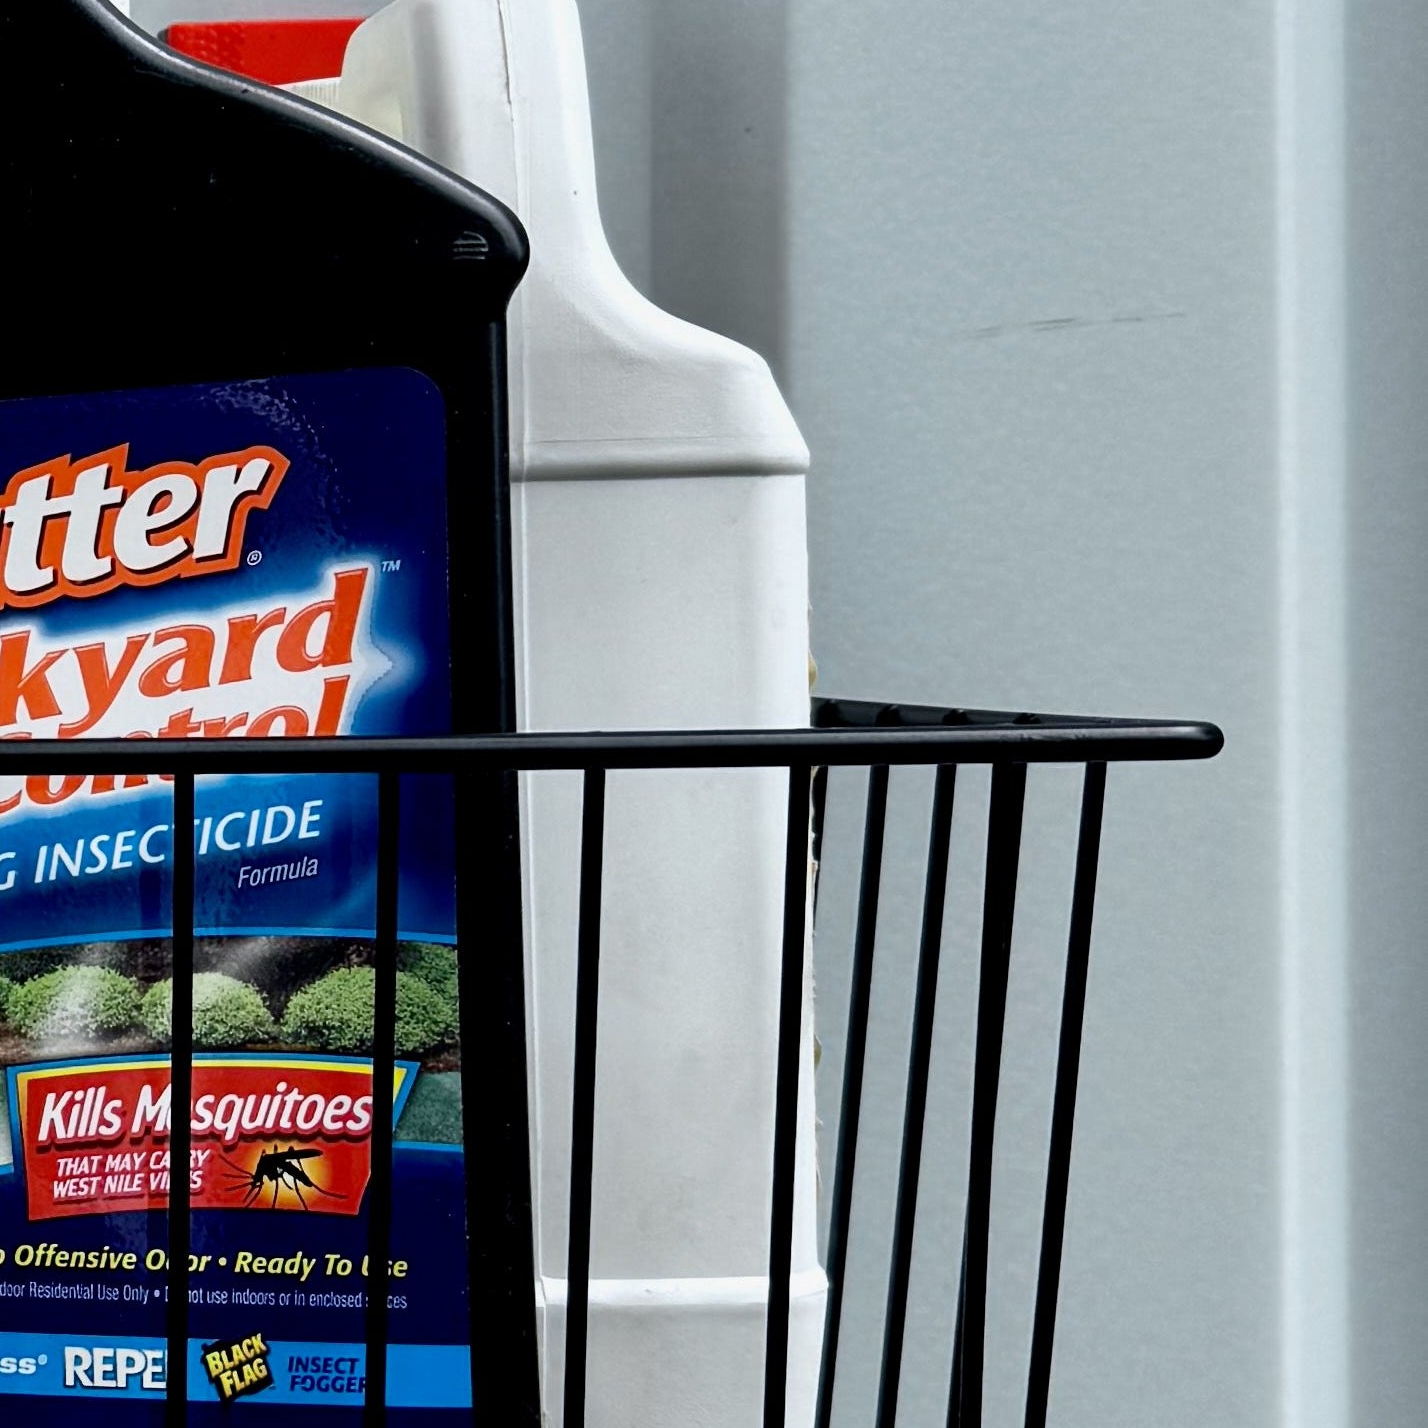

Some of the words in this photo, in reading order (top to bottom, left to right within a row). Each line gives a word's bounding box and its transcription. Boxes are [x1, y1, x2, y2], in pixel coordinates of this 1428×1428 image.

[237, 854, 320, 891] Formula
[38, 1082, 123, 1142] Kills
[130, 1081, 372, 1141] Msquitoes
[56, 1155, 100, 1177] THAT
[104, 1151, 147, 1172] MAY
[52, 1177, 101, 1199] WEST
[104, 1173, 142, 1195] NILE
[14, 1243, 137, 1270] Offensive
[234, 1250, 317, 1282] Ready
[325, 1253, 353, 1277] To
[29, 1281, 94, 1300] Residential
[97, 1283, 120, 1301] Use
[123, 1284, 149, 1305] Only
[207, 1290, 228, 1305] use
[231, 1288, 275, 1305] indoors
[279, 1293, 291, 1306] or
[294, 1290, 305, 1306] in
[309, 1291, 362, 1308] enclosed
[205, 1333, 267, 1376] BLACK
[222, 1358, 269, 1399] FLAG
[287, 1356, 361, 1376] INSECT
